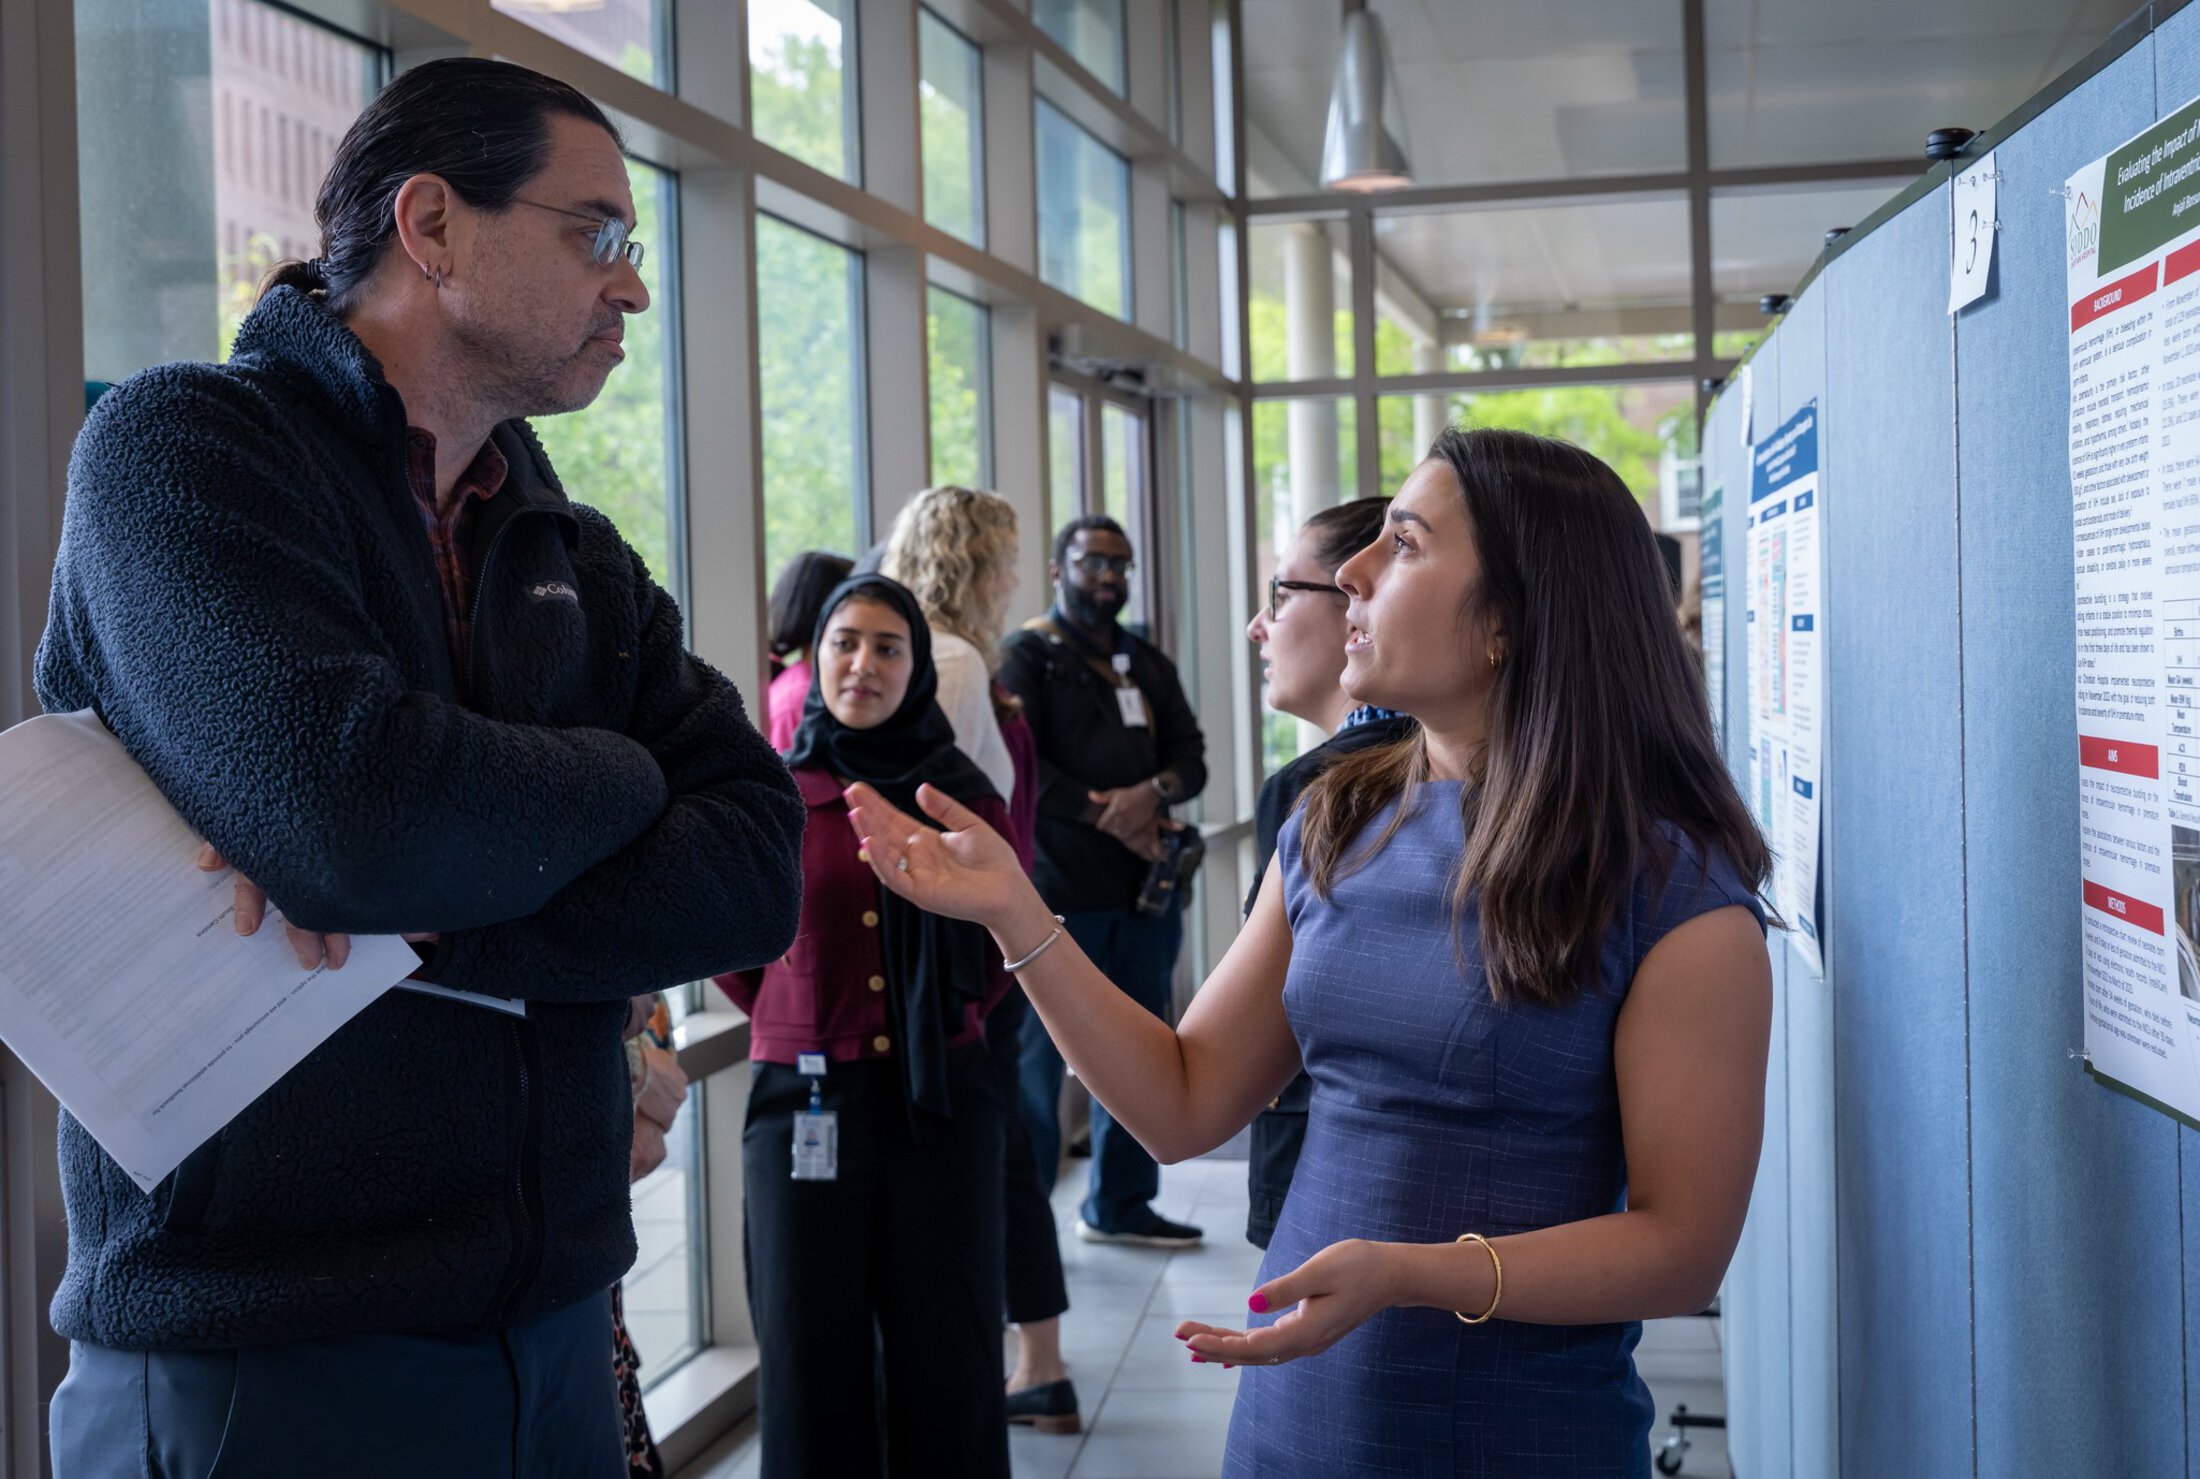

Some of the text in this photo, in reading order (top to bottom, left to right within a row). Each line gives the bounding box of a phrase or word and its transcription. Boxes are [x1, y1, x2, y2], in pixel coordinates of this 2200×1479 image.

[2118, 154, 2151, 186] Evaluating
[2152, 145, 2162, 166] the
[2163, 129, 2188, 159] Impact
[2188, 119, 2198, 143] of
[2124, 186, 2155, 213] Incidence
[2156, 173, 2164, 196] of
[1966, 209, 1978, 275] 3
